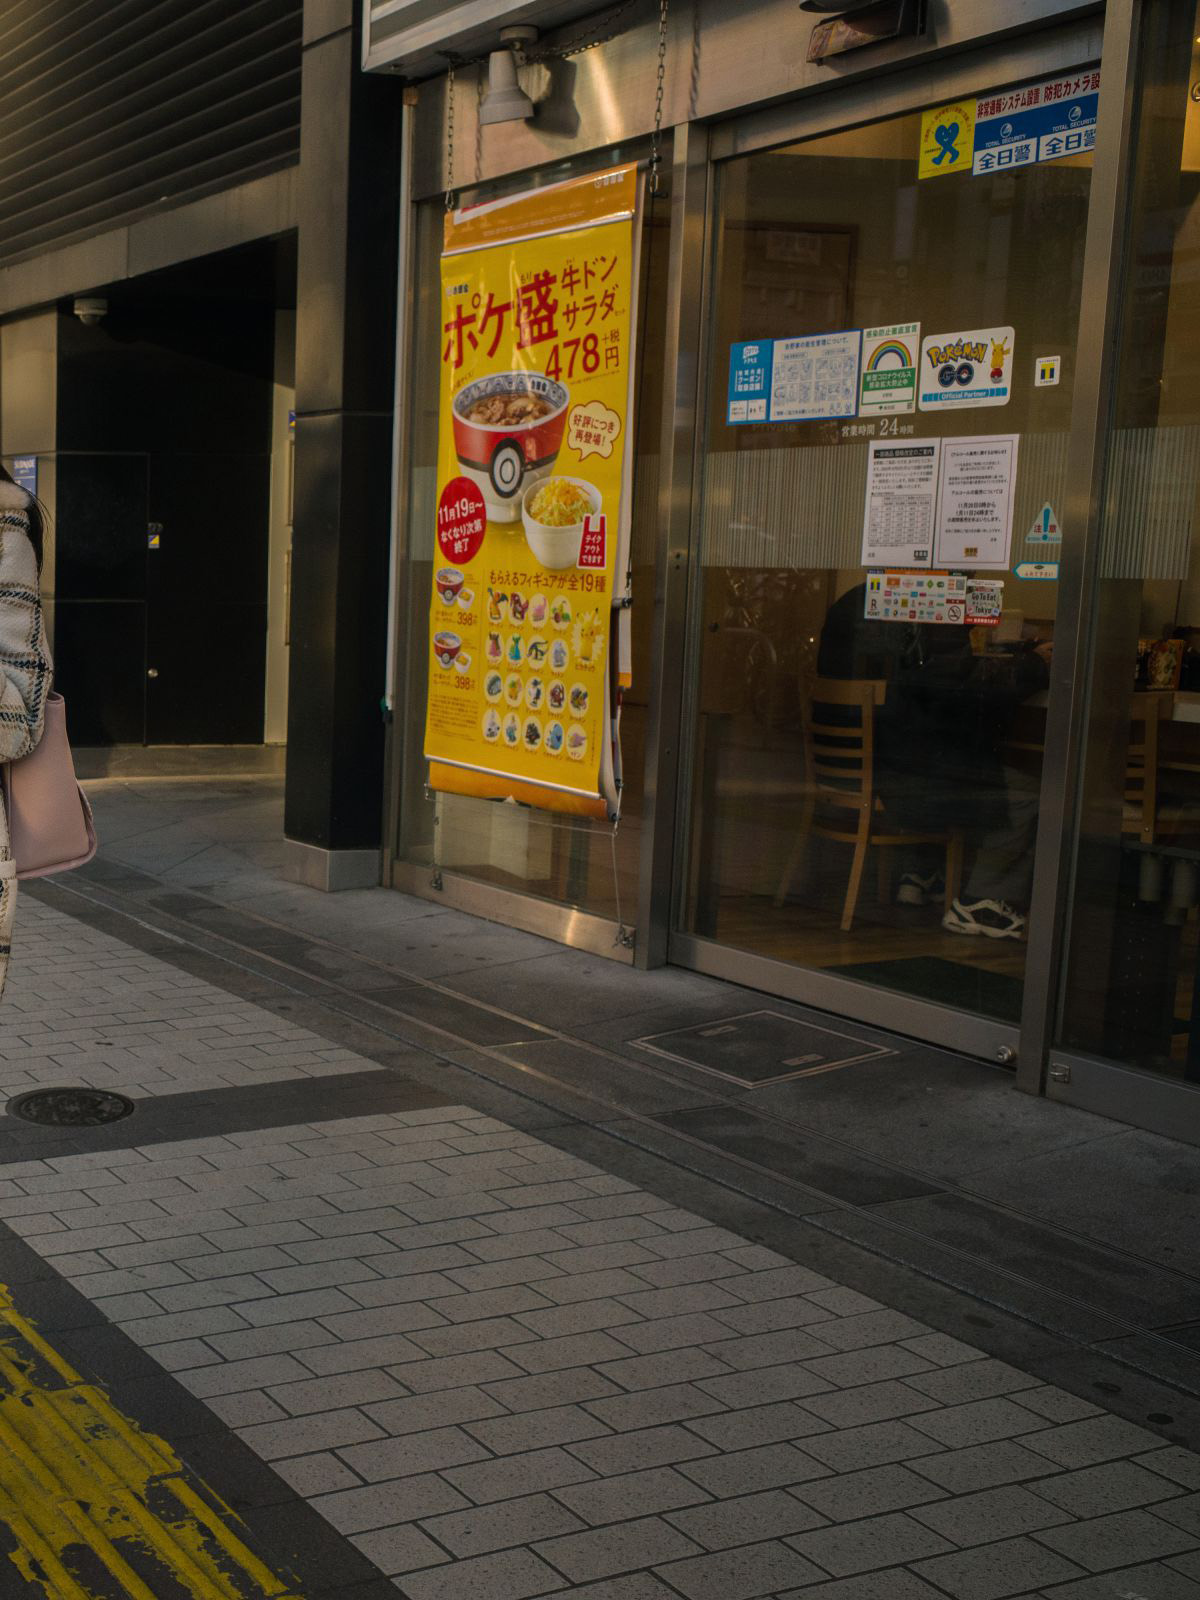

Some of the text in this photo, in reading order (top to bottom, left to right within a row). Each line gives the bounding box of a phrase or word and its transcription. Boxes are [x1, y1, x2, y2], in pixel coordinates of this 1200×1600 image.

[980, 143, 1031, 171] 全日警
[561, 256, 618, 296] 牛ドン
[443, 269, 559, 370] ポケ盛
[562, 284, 619, 332] サラダ
[544, 332, 600, 383] 478
[605, 346, 620, 370] 円
[942, 390, 987, 400] Official Partner
[573, 414, 614, 434] 好評につき
[841, 416, 915, 437] 営業時間 24時間
[440, 519, 483, 543] なくなり次第
[453, 538, 470, 554] 終了
[584, 544, 601, 554] アウト
[489, 570, 607, 593] もらえるフィギュアが全19種
[456, 612, 473, 626] 398
[453, 675, 471, 690] 398
